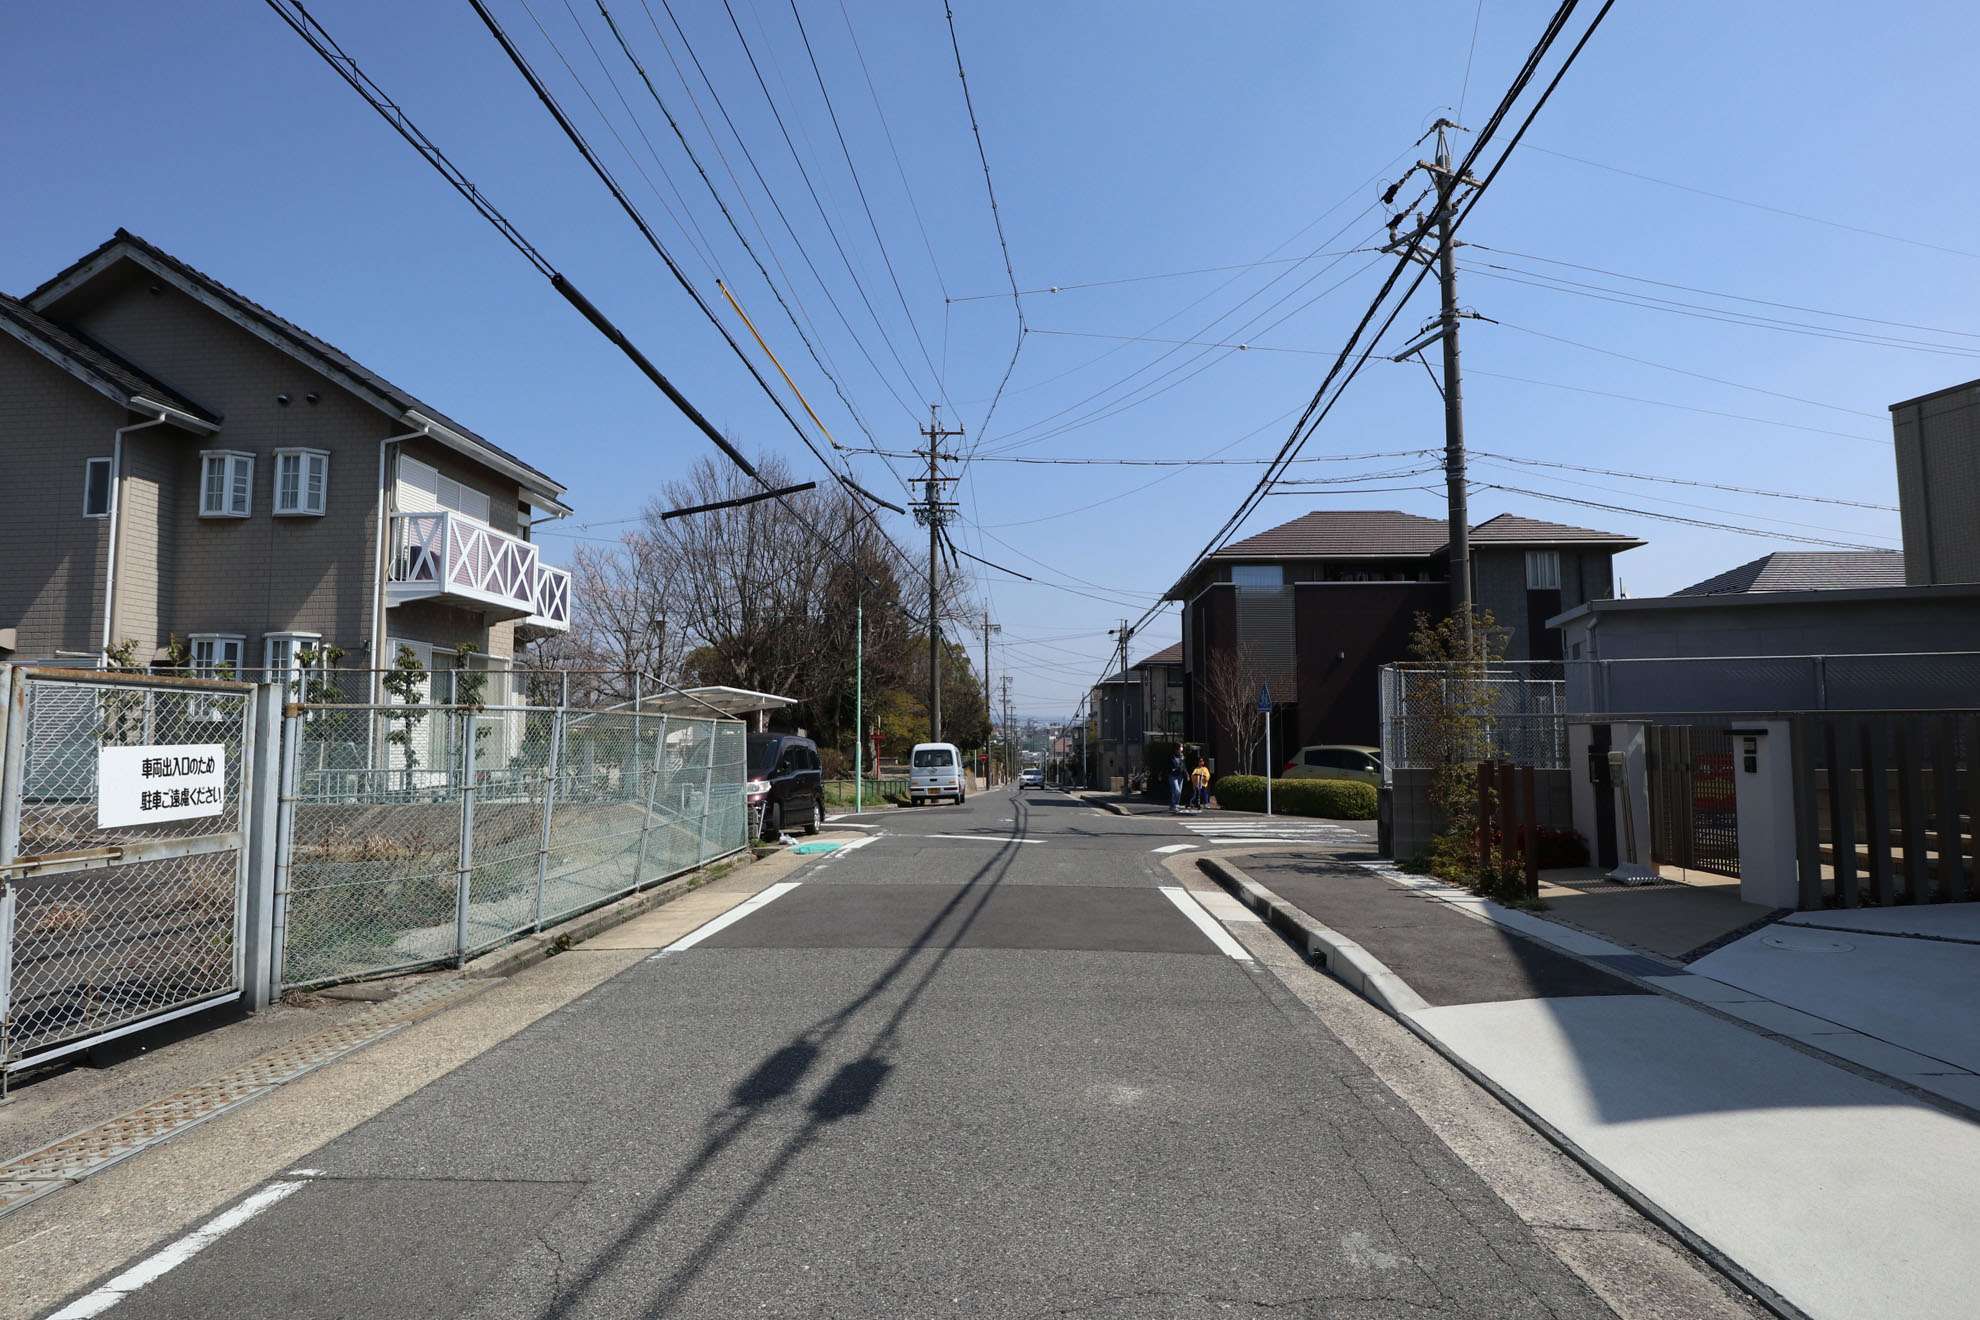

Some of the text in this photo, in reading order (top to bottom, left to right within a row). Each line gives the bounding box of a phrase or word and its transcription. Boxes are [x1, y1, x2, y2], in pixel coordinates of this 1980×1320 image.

[142, 756, 215, 779] 車両出入口のため
